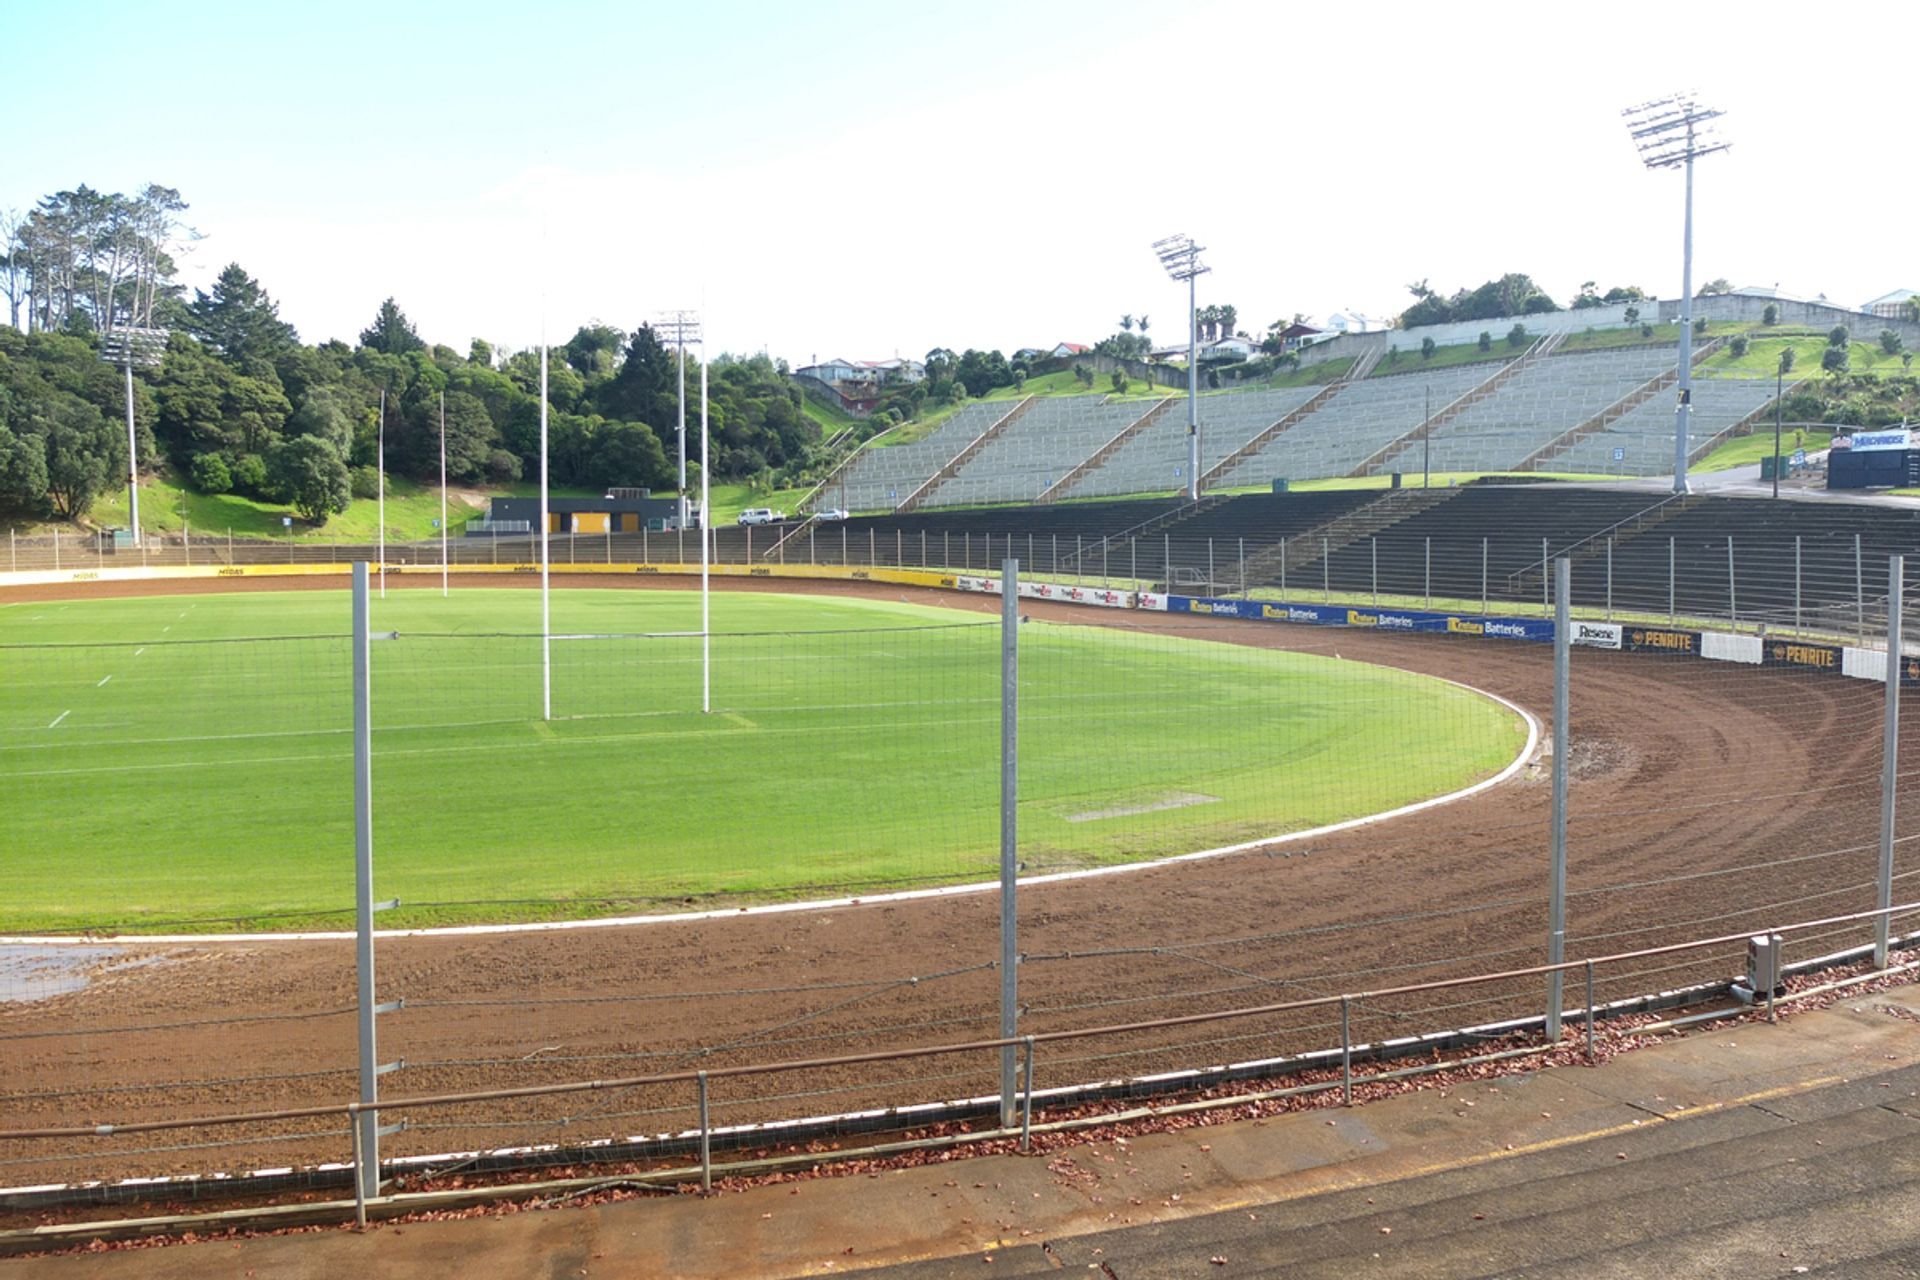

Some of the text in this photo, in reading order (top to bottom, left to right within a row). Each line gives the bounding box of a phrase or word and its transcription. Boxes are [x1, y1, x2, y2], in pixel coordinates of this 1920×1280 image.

[1379, 614, 1413, 627] Batteries
[1485, 622, 1525, 636] Batteries
[1579, 625, 1614, 639] Resene
[1645, 632, 1692, 650] PENRITE
[1786, 646, 1834, 667] PENRITE
